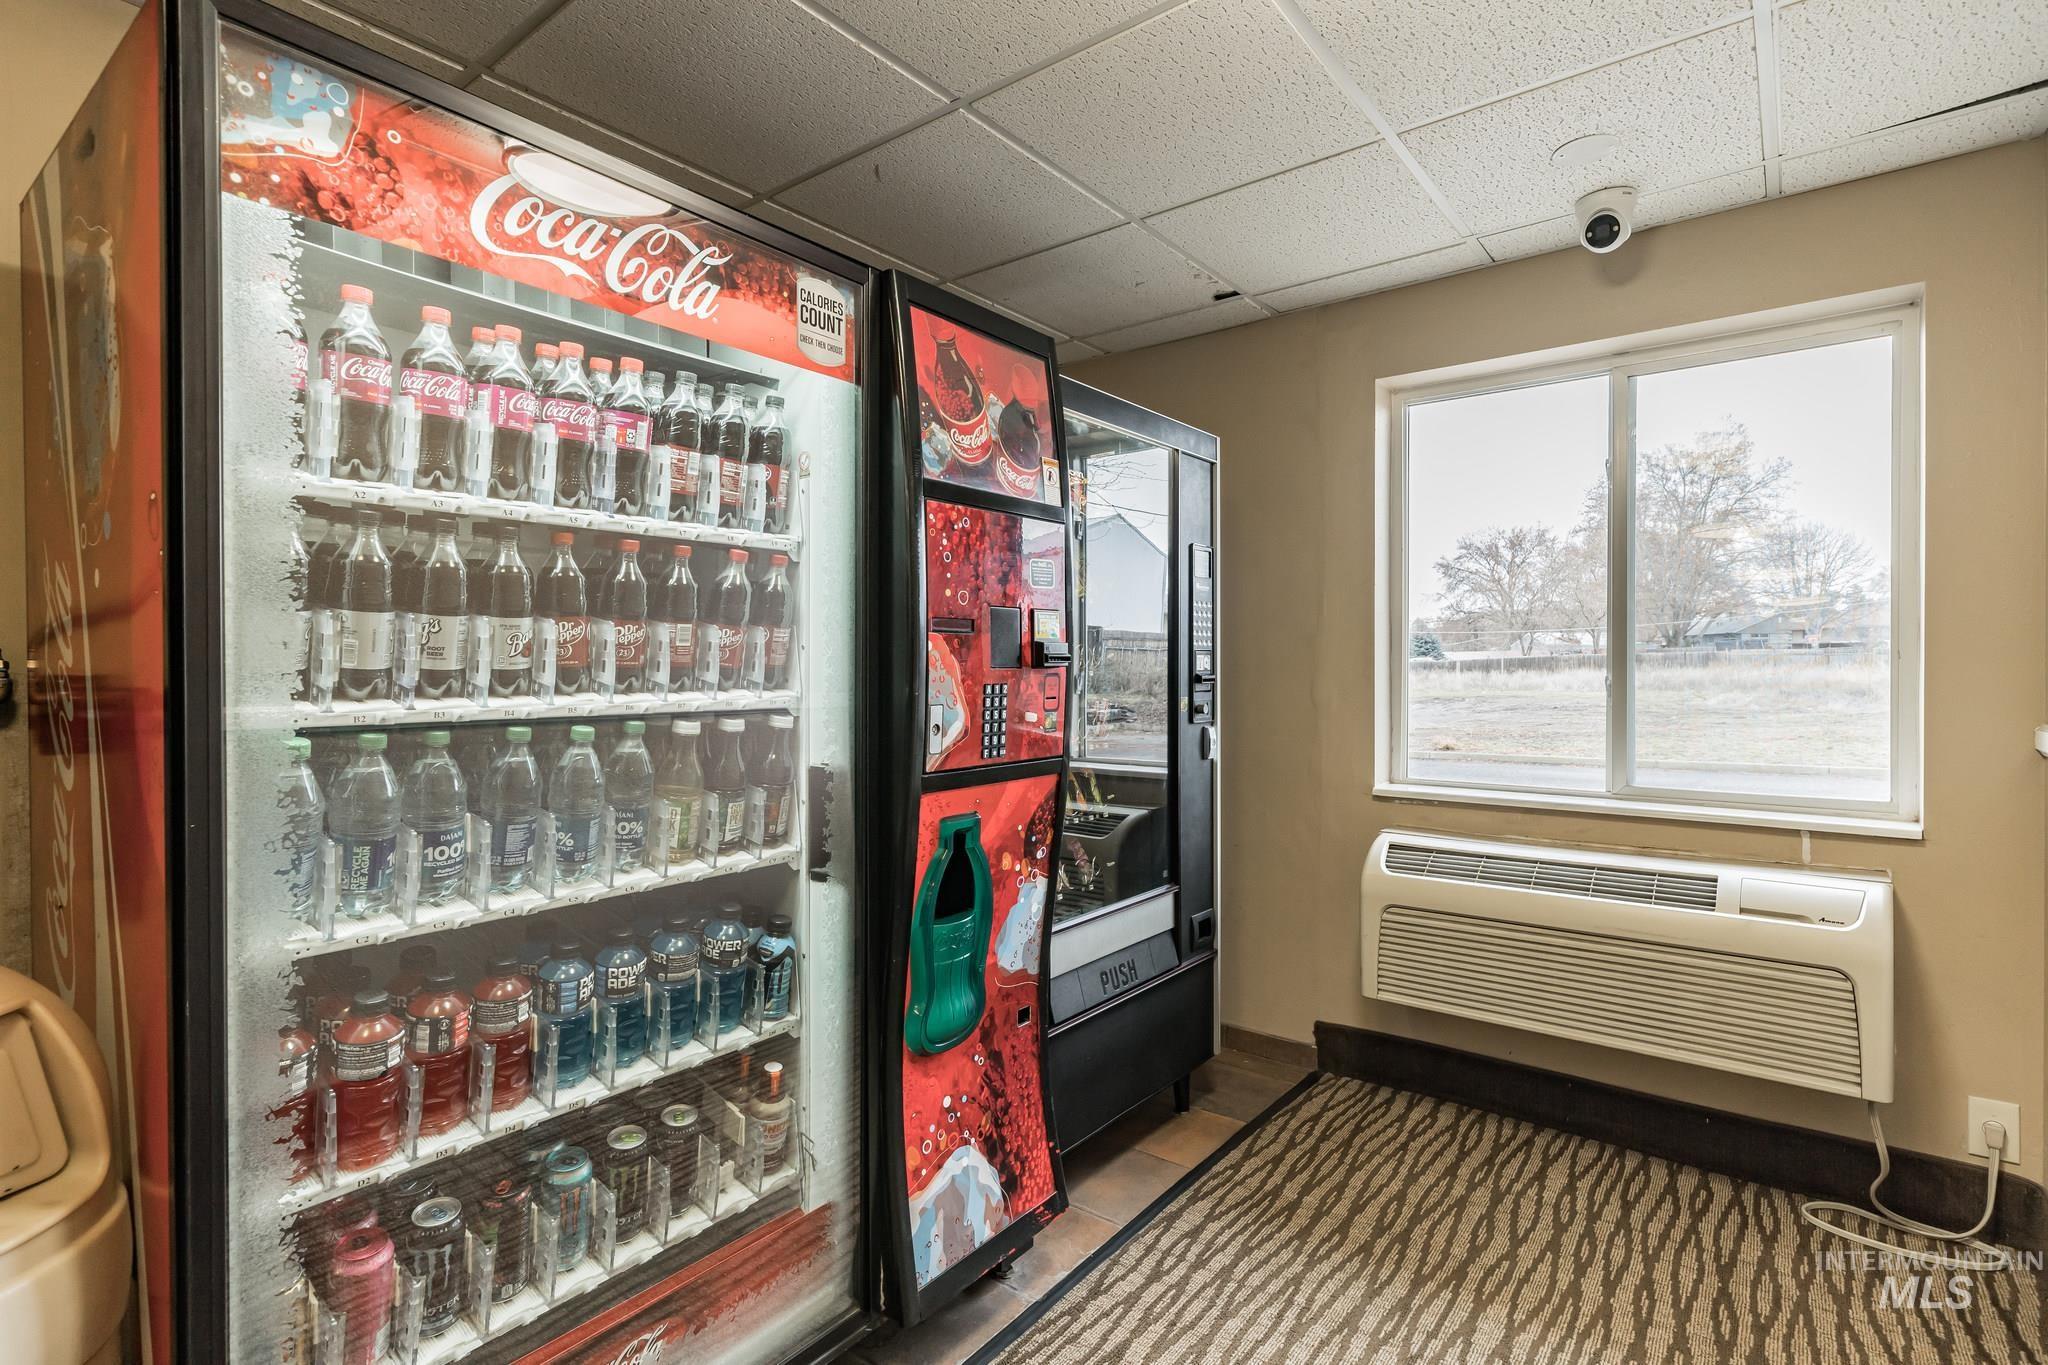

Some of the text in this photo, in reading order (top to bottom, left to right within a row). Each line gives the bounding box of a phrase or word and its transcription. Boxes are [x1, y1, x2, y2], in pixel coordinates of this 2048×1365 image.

[470, 174, 733, 320] Coca-Cola
[800, 288, 843, 316] CALORIES
[801, 304, 843, 336] COUNT
[800, 334, 843, 355] CHECK THEN CHOOSE
[400, 370, 464, 402] Coca-Cola
[542, 400, 595, 427] Coca-Cola
[951, 425, 988, 449] Coca-Cola
[353, 490, 366, 498] A2
[503, 509, 513, 517] A4
[559, 621, 574, 633] Dr
[625, 624, 638, 635] Dr
[986, 685, 991, 694] A
[1003, 685, 1008, 694] 2
[986, 697, 1007, 707] B 3 4
[353, 715, 366, 723] B2
[434, 711, 445, 719] B3
[985, 711, 1007, 720] C 5 6
[985, 724, 990, 733] D
[994, 723, 998, 732] 7
[984, 736, 989, 746] E
[984, 749, 989, 758] F
[351, 846, 362, 890] RECYCLE
[360, 846, 371, 890] ME AGAIN
[1100, 958, 1138, 996] PUSH
[607, 976, 637, 990] ADE
[568, 1101, 579, 1110] D5
[505, 1125, 516, 1134] D4
[436, 1150, 448, 1159] D3
[357, 1177, 371, 1188] D2
